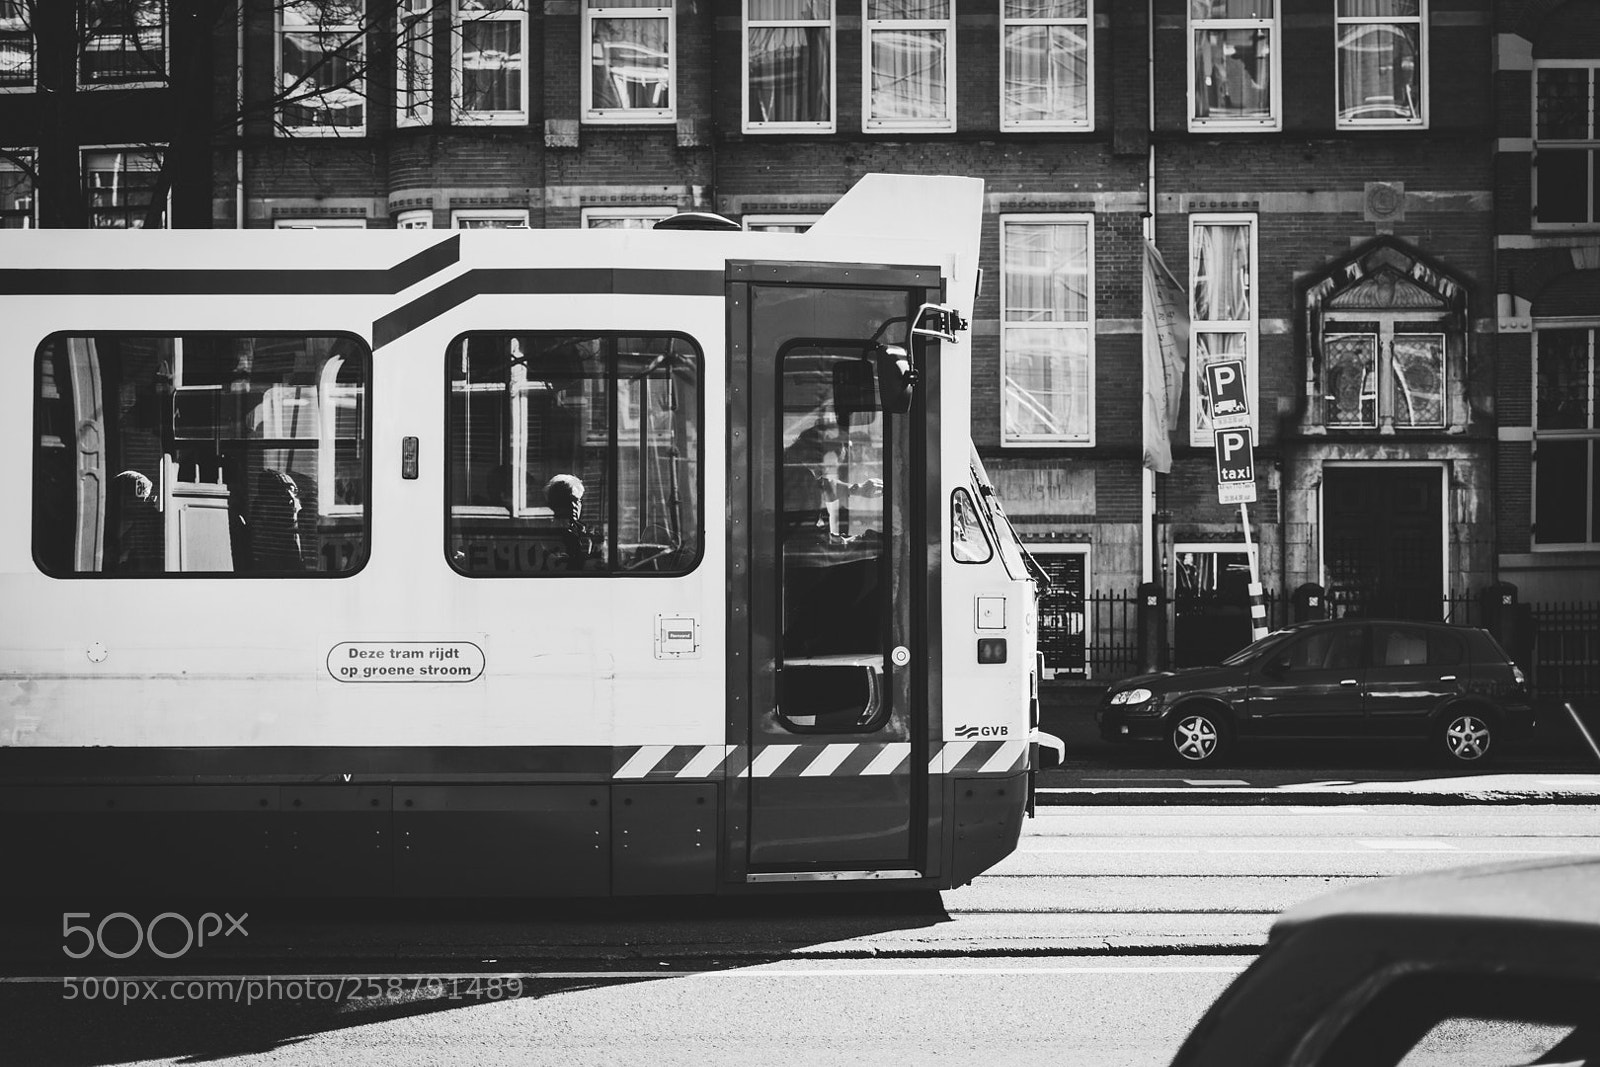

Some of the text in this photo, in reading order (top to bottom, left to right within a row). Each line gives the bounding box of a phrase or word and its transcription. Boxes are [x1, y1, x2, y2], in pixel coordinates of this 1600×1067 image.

[1214, 366, 1236, 396] P
[1223, 432, 1244, 462] P
[1221, 466, 1251, 480] taxi
[348, 648, 460, 661] Deze tram rijdt
[340, 665, 471, 678] op groene stroom
[981, 726, 1009, 736] GVB
